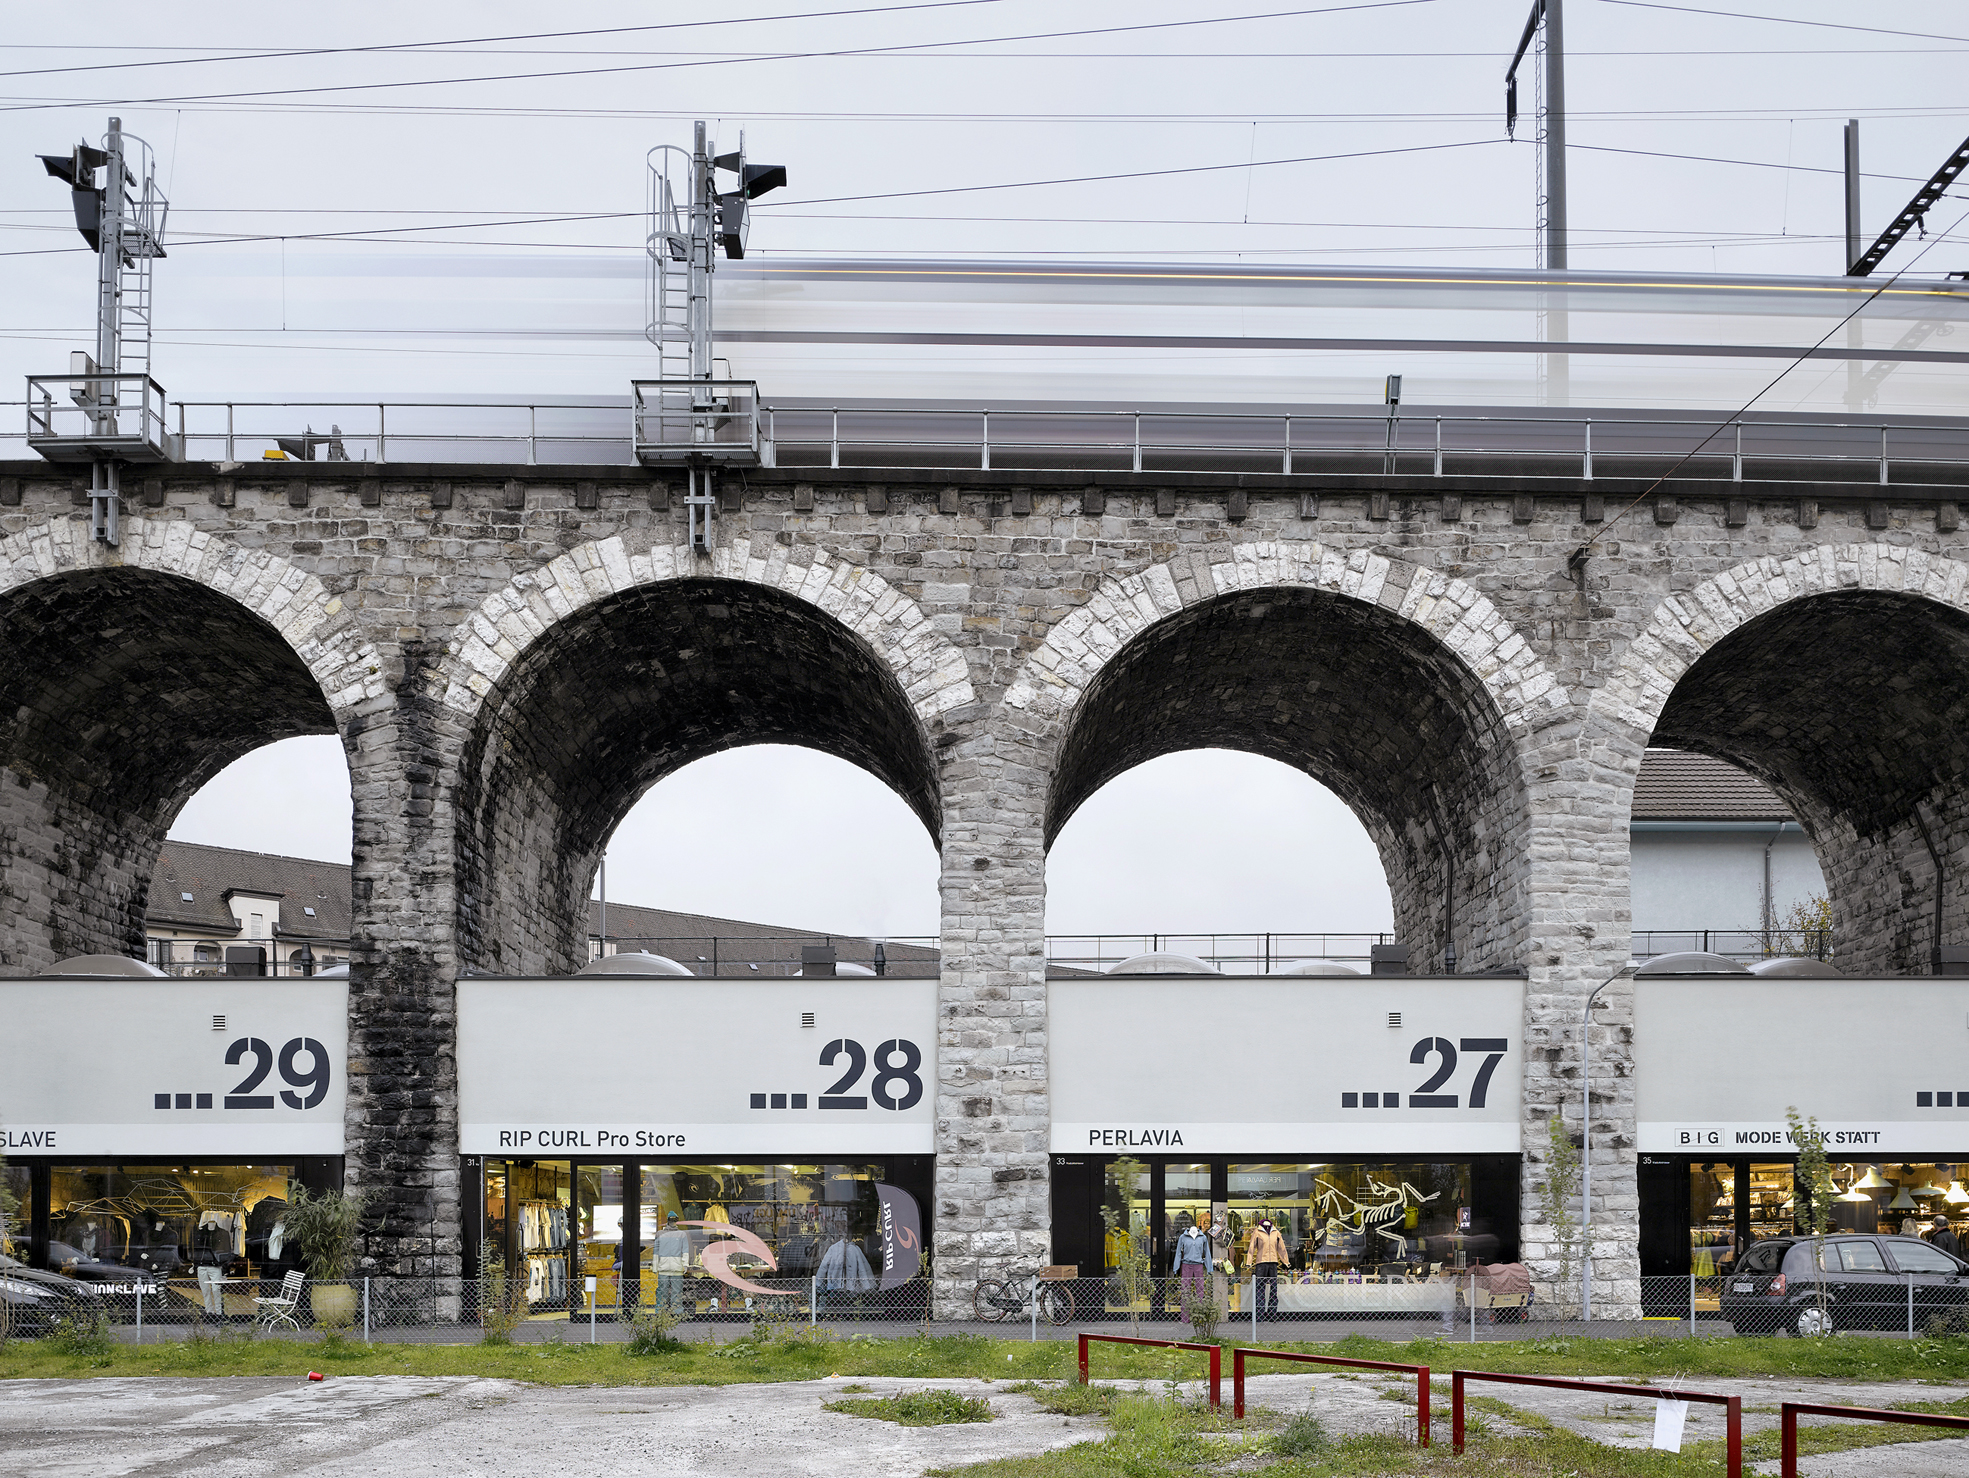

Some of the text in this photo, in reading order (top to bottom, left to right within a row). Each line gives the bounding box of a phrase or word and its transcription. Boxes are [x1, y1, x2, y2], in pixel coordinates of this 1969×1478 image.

[500, 1130, 686, 1147] RIP CURL Pro Store
[1089, 1129, 1184, 1146] PERLAVIA
[1735, 1131, 1781, 1144] MODE
[1835, 1131, 1880, 1144] STATT
[467, 1158, 475, 1167] 31
[1056, 1157, 1066, 1166] 33
[1642, 1156, 1652, 1165] 35
